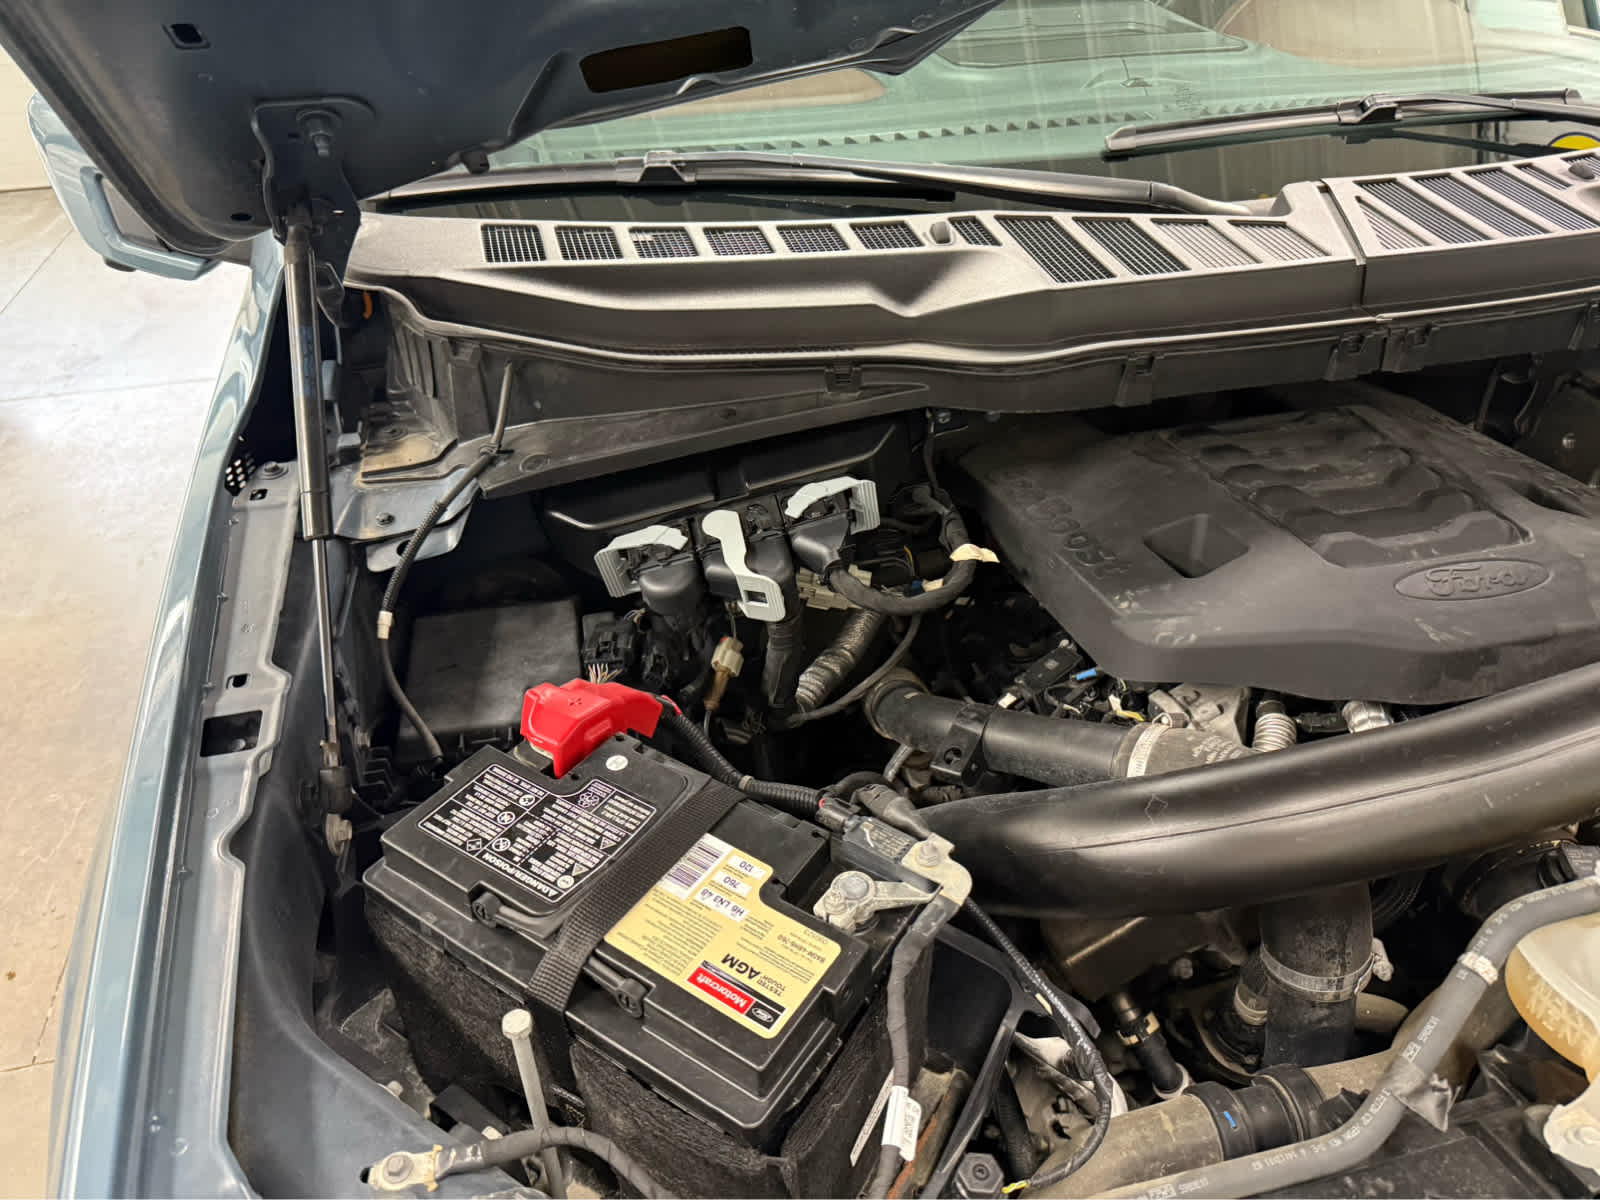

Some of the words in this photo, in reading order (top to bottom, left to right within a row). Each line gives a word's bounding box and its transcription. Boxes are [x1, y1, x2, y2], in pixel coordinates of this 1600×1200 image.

[1422, 563, 1536, 598] Ford
[482, 852, 551, 894] DANGER/POISON
[739, 861, 754, 873] 120
[723, 876, 740, 889] 760
[721, 953, 761, 980] AGM
[696, 973, 748, 1008] Motorcraft
[756, 979, 782, 996] TESTED
